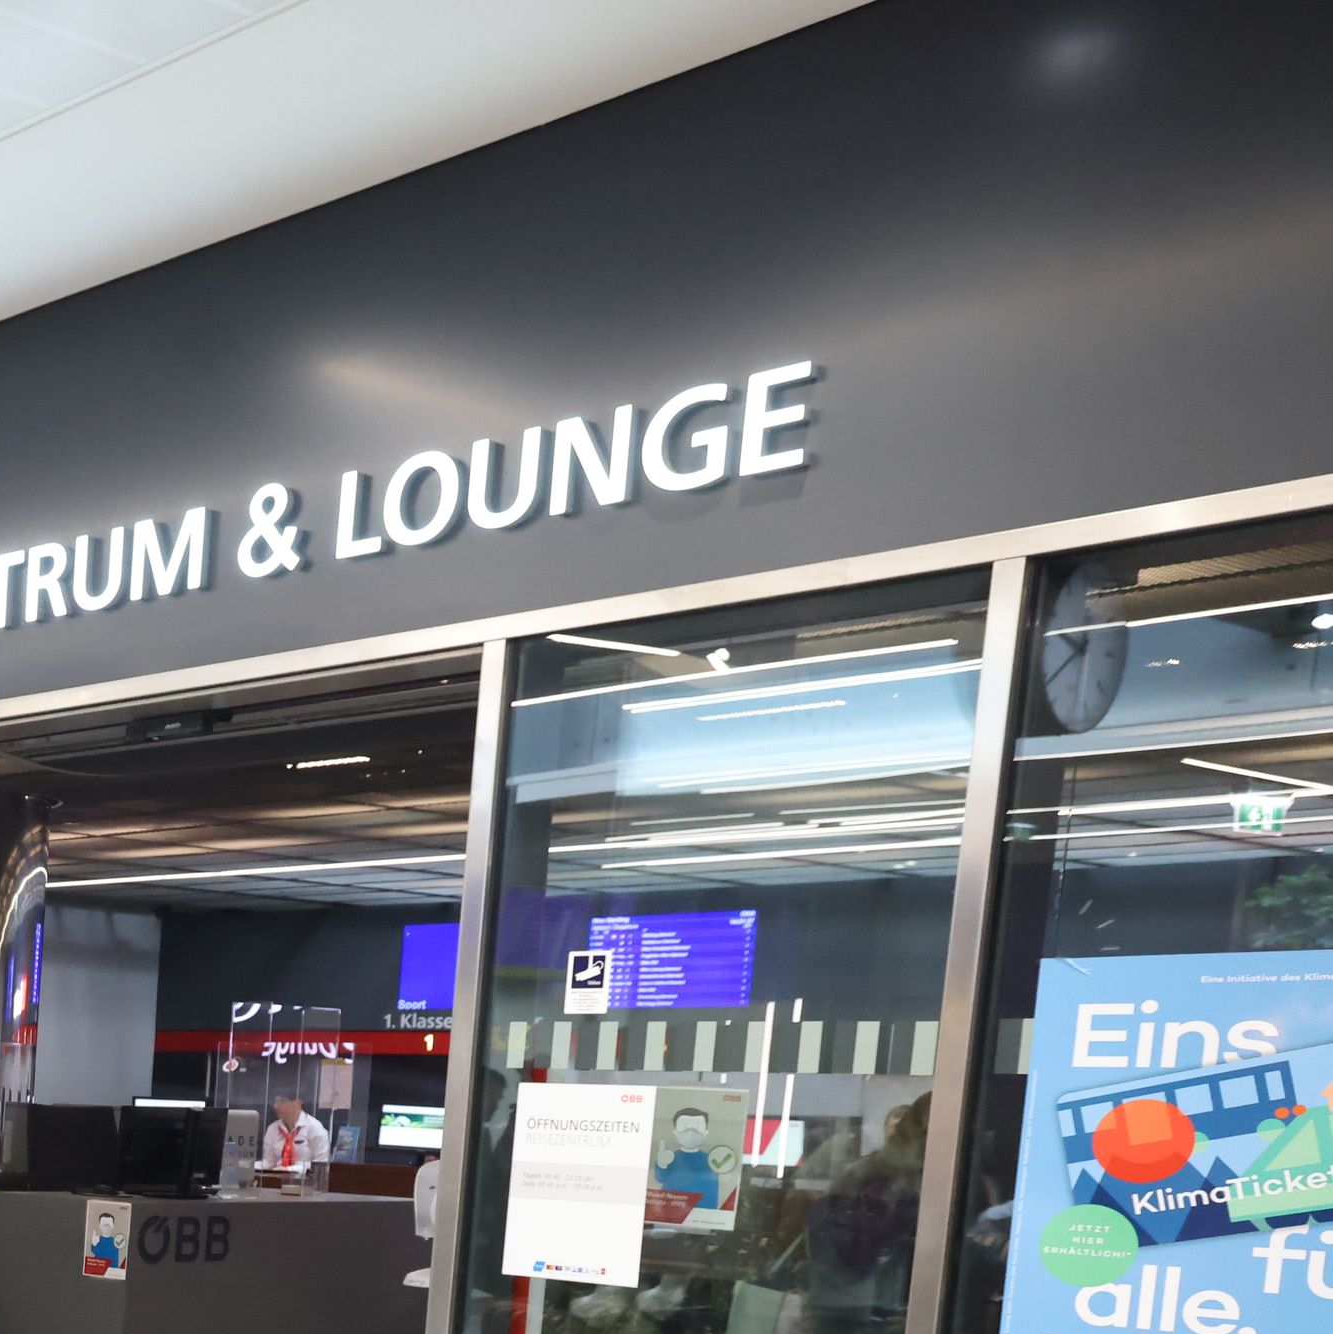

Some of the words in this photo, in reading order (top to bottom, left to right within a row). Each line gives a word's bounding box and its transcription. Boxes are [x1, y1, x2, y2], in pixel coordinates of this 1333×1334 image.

[237, 482, 302, 578] &
[335, 360, 813, 560] LOUNGE
[1200, 974, 1225, 983] Eine
[1227, 973, 1278, 983] Initiative
[1280, 973, 1302, 981] des
[384, 1013, 396, 1029] 1.
[399, 1012, 454, 1030] Klasse
[423, 1033, 434, 1052] 1
[1072, 999, 1280, 1069] Eins
[526, 1115, 641, 1134] ÖFFNUNGSZEITEN
[525, 1132, 612, 1149] REISEZENTRUM
[1069, 1224, 1112, 1233] JETZT
[138, 1214, 231, 1265] ÖBB
[1073, 1236, 1105, 1245] HIER
